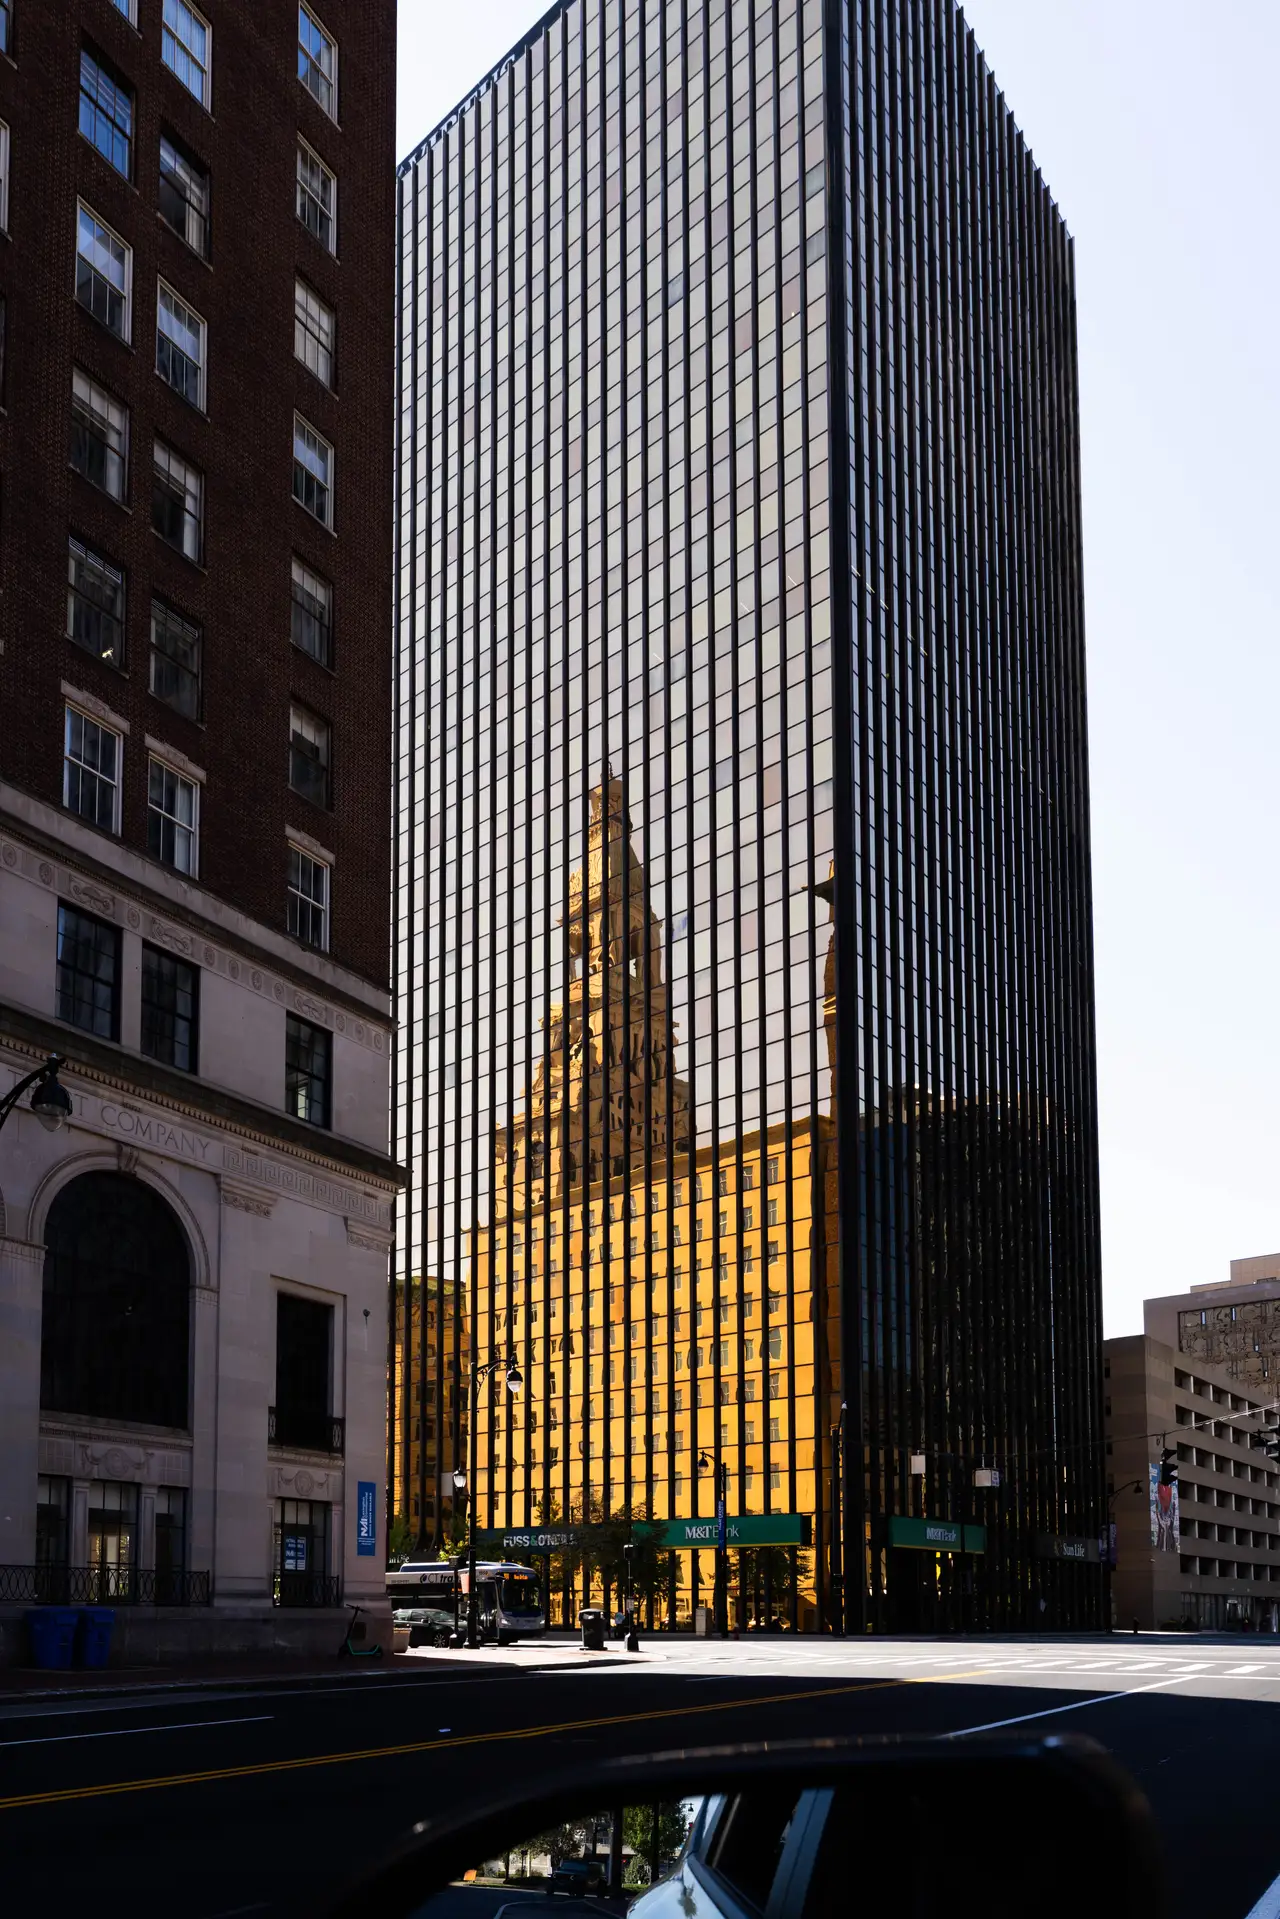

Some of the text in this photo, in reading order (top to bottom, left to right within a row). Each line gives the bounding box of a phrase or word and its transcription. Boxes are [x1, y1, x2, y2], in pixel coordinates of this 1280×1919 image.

[7, 1068, 210, 1159] TRT COMPANY
[685, 1524, 739, 1539] M&TBnk
